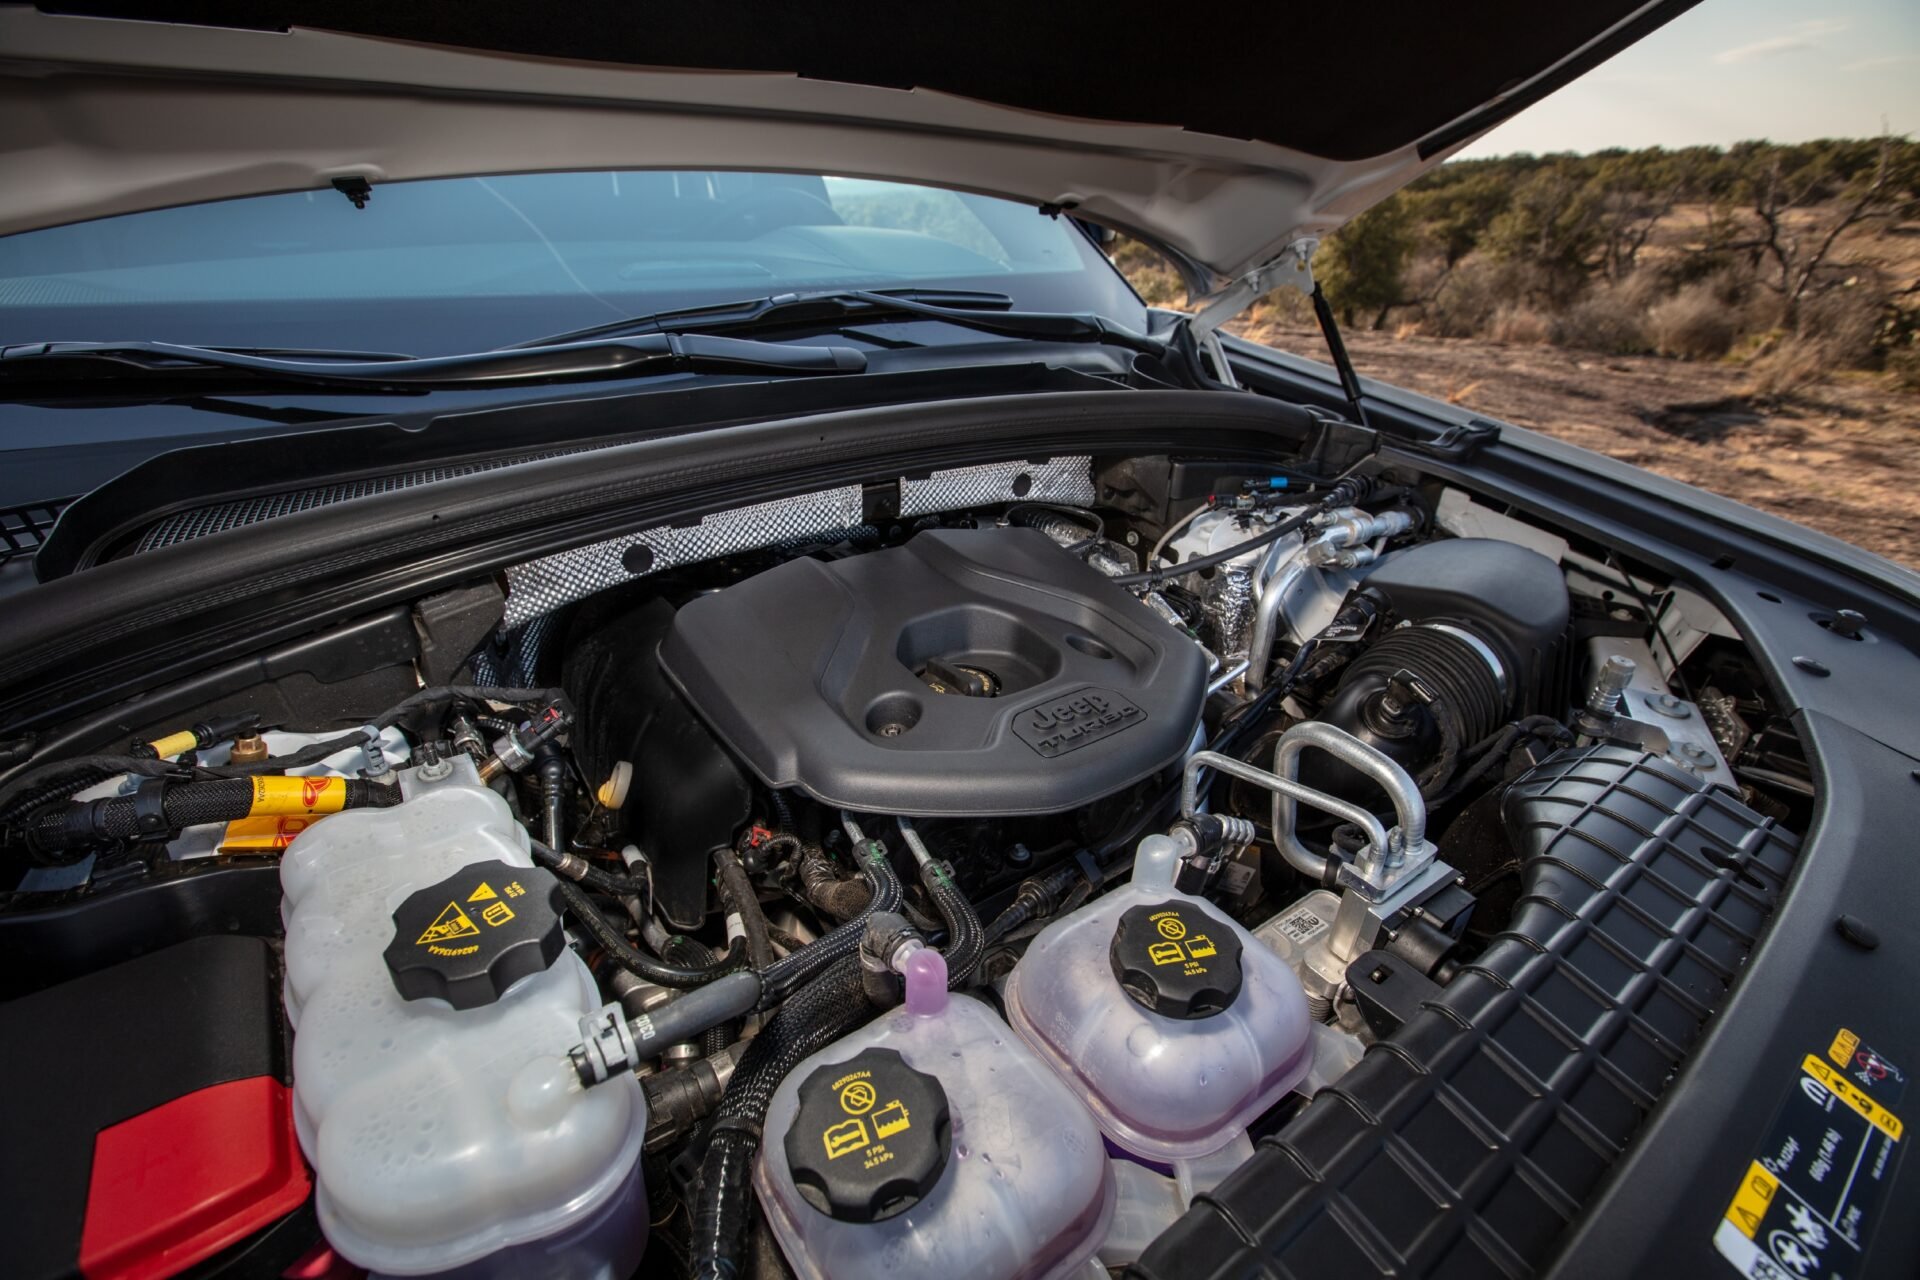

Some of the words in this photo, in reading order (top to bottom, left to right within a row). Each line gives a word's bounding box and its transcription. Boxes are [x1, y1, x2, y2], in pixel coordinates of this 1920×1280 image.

[1033, 695, 1110, 731] Jeep
[1038, 705, 1141, 749] TURBO
[864, 1157, 880, 1170] 34.5
[879, 1152, 894, 1163] kPa
[866, 1149, 873, 1157] 5
[872, 1144, 885, 1155] PSI
